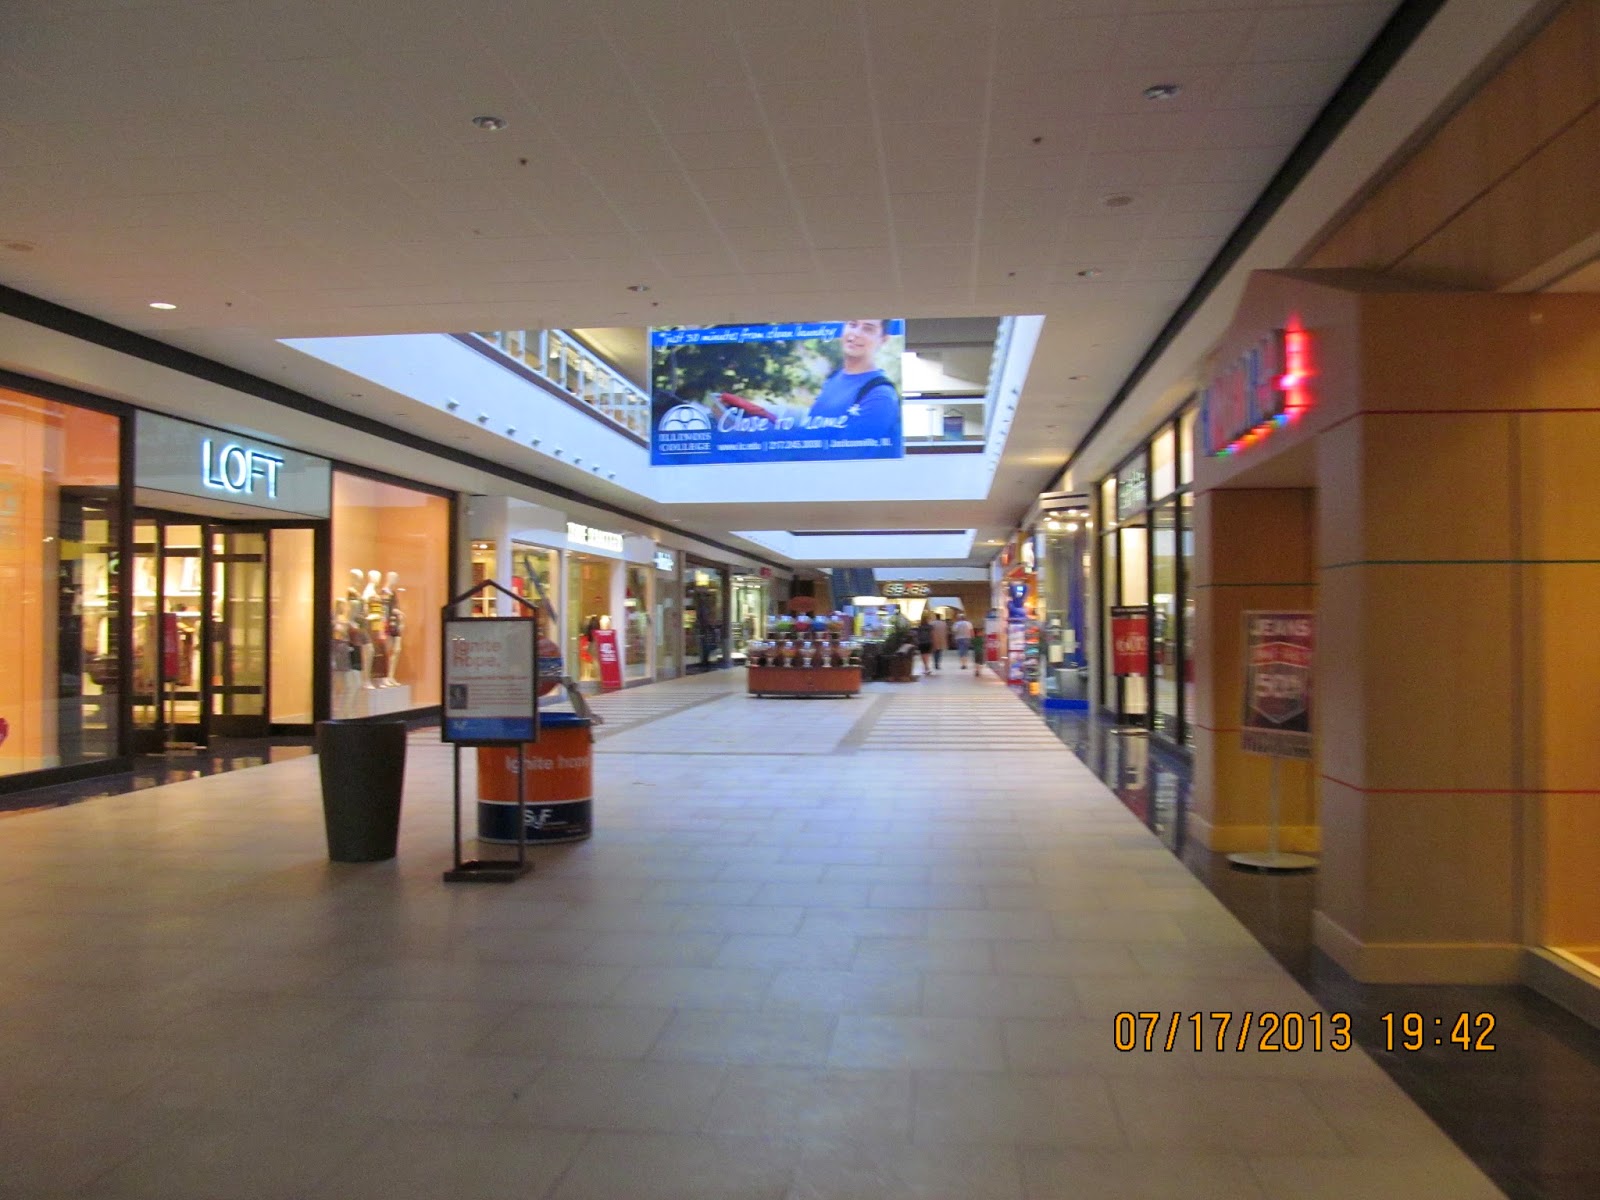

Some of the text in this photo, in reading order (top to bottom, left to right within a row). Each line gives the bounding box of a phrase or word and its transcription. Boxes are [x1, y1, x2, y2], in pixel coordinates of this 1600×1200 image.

[737, 327, 764, 343] from
[717, 406, 769, 432] Close
[658, 432, 712, 442] ILLINOIS
[659, 442, 712, 452] COLLEGE
[203, 439, 286, 498] LOFT
